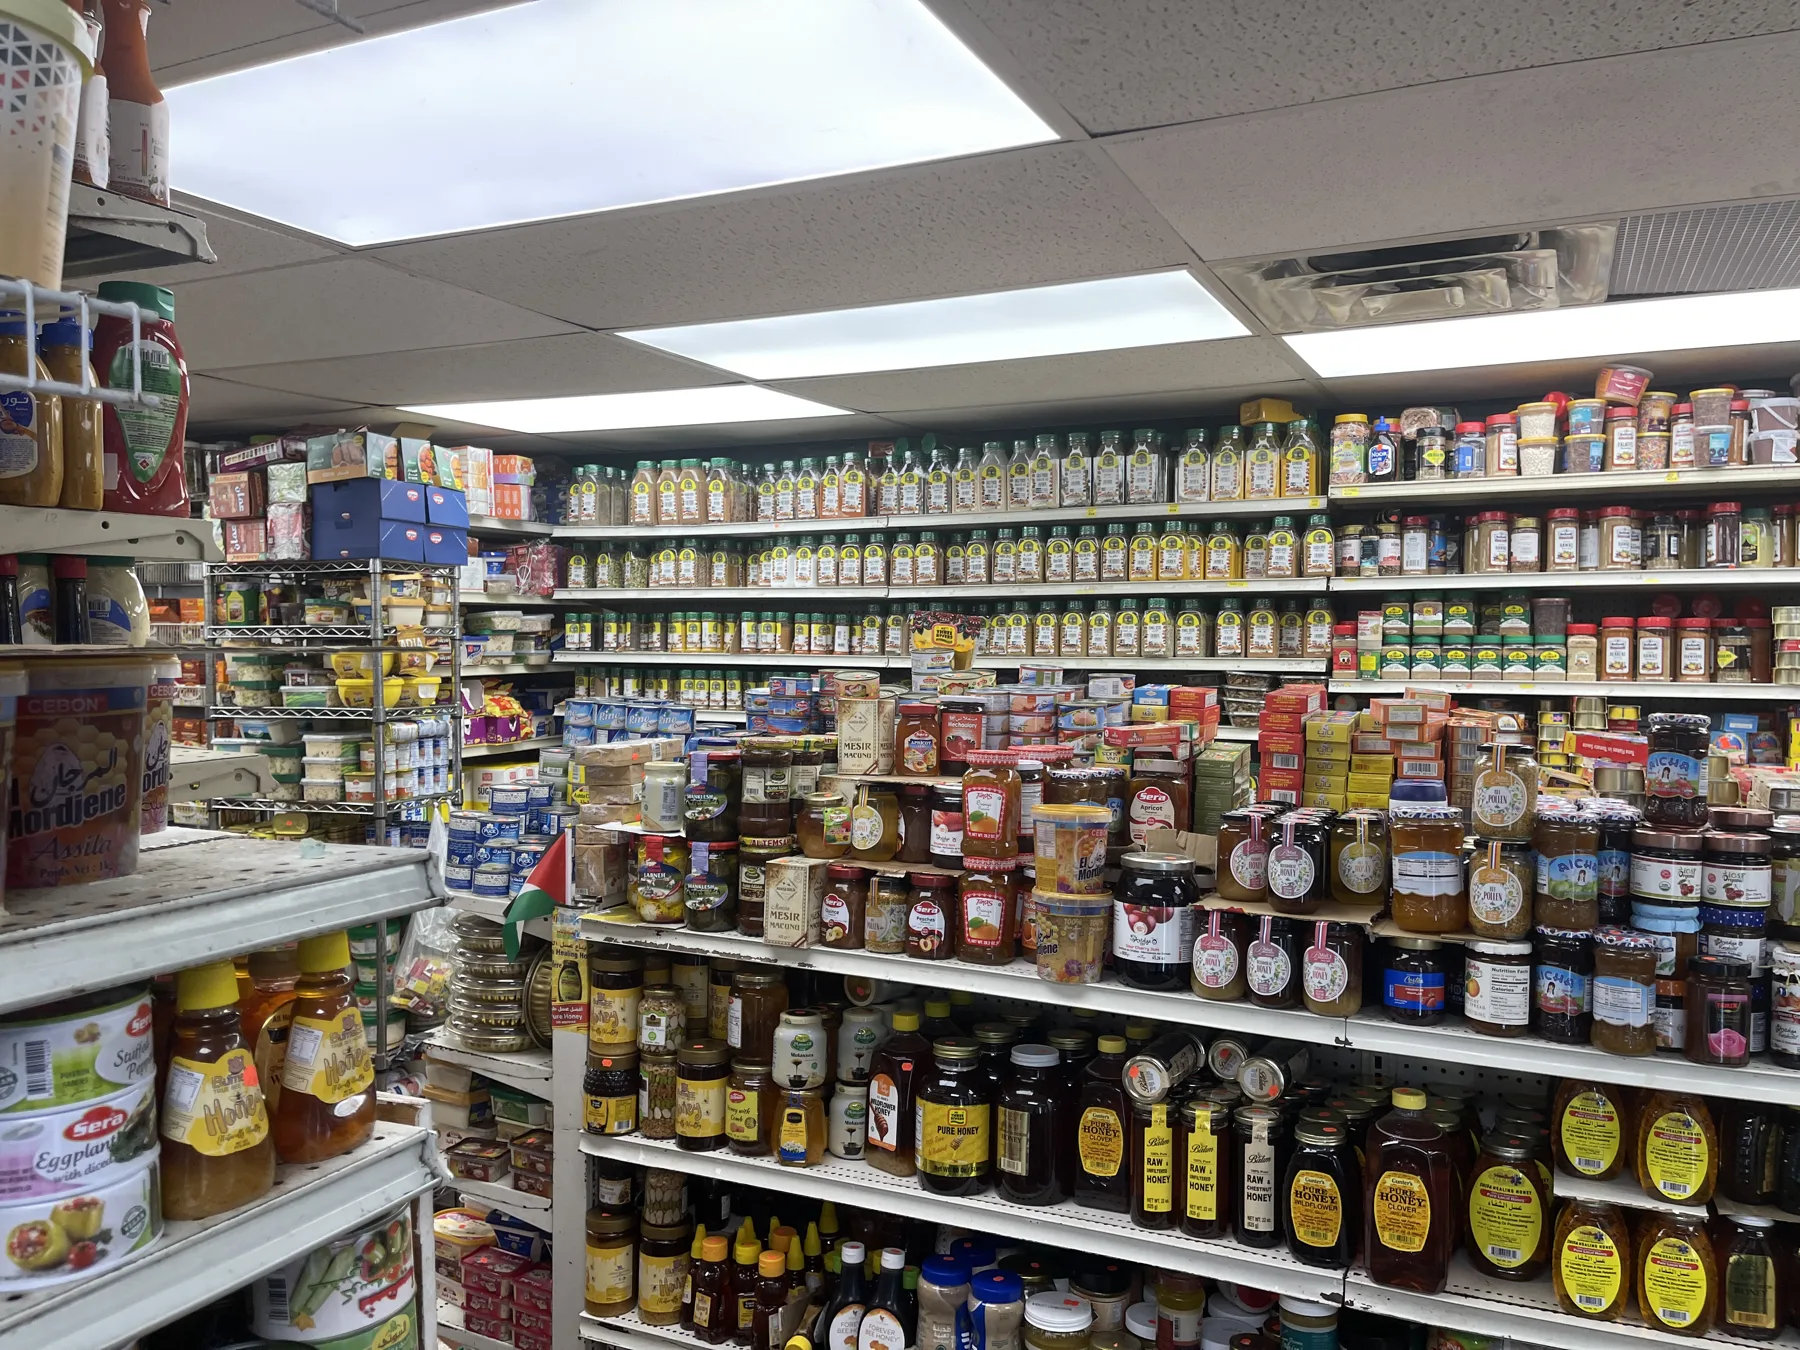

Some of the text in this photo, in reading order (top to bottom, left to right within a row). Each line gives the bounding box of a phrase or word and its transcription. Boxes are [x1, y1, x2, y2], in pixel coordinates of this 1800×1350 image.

[28, 698, 99, 714] CEBON
[1649, 757, 1690, 772] AICHA
[1138, 792, 1169, 803] Sera
[1140, 804, 1163, 813] Apricot
[29, 834, 112, 862] Assila
[1079, 857, 1088, 869] El
[1279, 867, 1297, 877] HONEY
[823, 898, 844, 908] Sera
[915, 905, 939, 915] Sera
[769, 921, 801, 931] MACUNU
[555, 949, 579, 959] Healing
[1256, 965, 1273, 975] HONEY
[563, 1013, 583, 1021] Honey
[870, 1097, 896, 1112] WILDFLOWER
[203, 1090, 265, 1137] Honey
[874, 1105, 891, 1117] HONEY
[73, 1111, 125, 1139] Sera
[1090, 1120, 1112, 1129] PURE
[937, 1125, 980, 1136] PURE HONEY
[1082, 1124, 1120, 1138] HONEY
[1089, 1134, 1113, 1143] CLOVER
[1146, 1157, 1163, 1166] RAW
[1190, 1163, 1206, 1174] RAW
[53, 1166, 83, 1184] with
[1146, 1175, 1171, 1184] HONEY
[1246, 1174, 1264, 1184] RAW
[1189, 1181, 1215, 1192] HONEY
[1246, 1184, 1272, 1192] CHESTNUT
[1302, 1185, 1328, 1195] PURE
[1389, 1187, 1415, 1197] PURE
[1246, 1191, 1273, 1202] HONEY
[1294, 1189, 1338, 1204] HONEY
[1380, 1191, 1426, 1207] HONEY
[1294, 1199, 1338, 1211] WILDFLOWER
[1388, 1202, 1417, 1213] CLOVER
[868, 1323, 896, 1336] FOREVER
[865, 1329, 899, 1343] BEE HONEY
